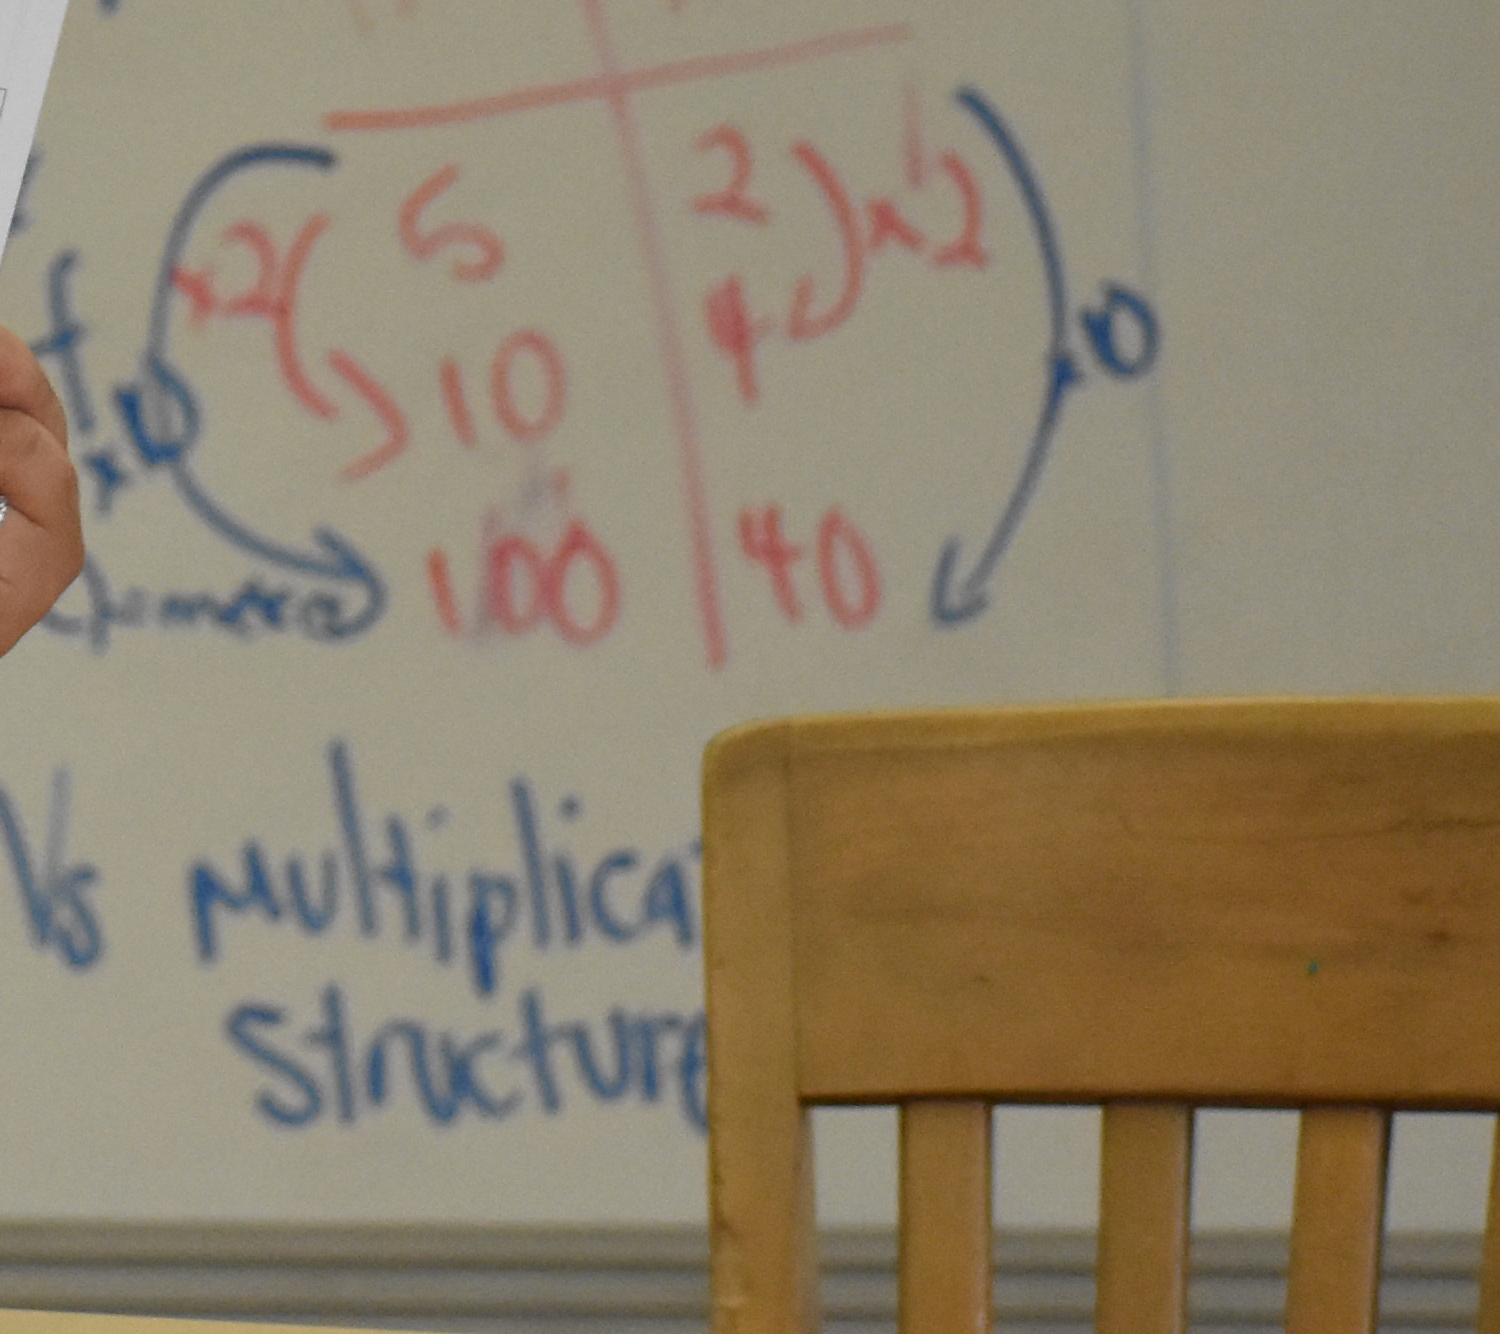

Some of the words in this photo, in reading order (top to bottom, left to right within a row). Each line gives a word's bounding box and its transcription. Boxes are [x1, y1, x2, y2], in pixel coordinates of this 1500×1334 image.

[396, 161, 504, 284] 5
[691, 125, 772, 224] 2
[440, 326, 567, 449] 10
[736, 503, 882, 631] 40
[188, 736, 703, 998] Multiplica
